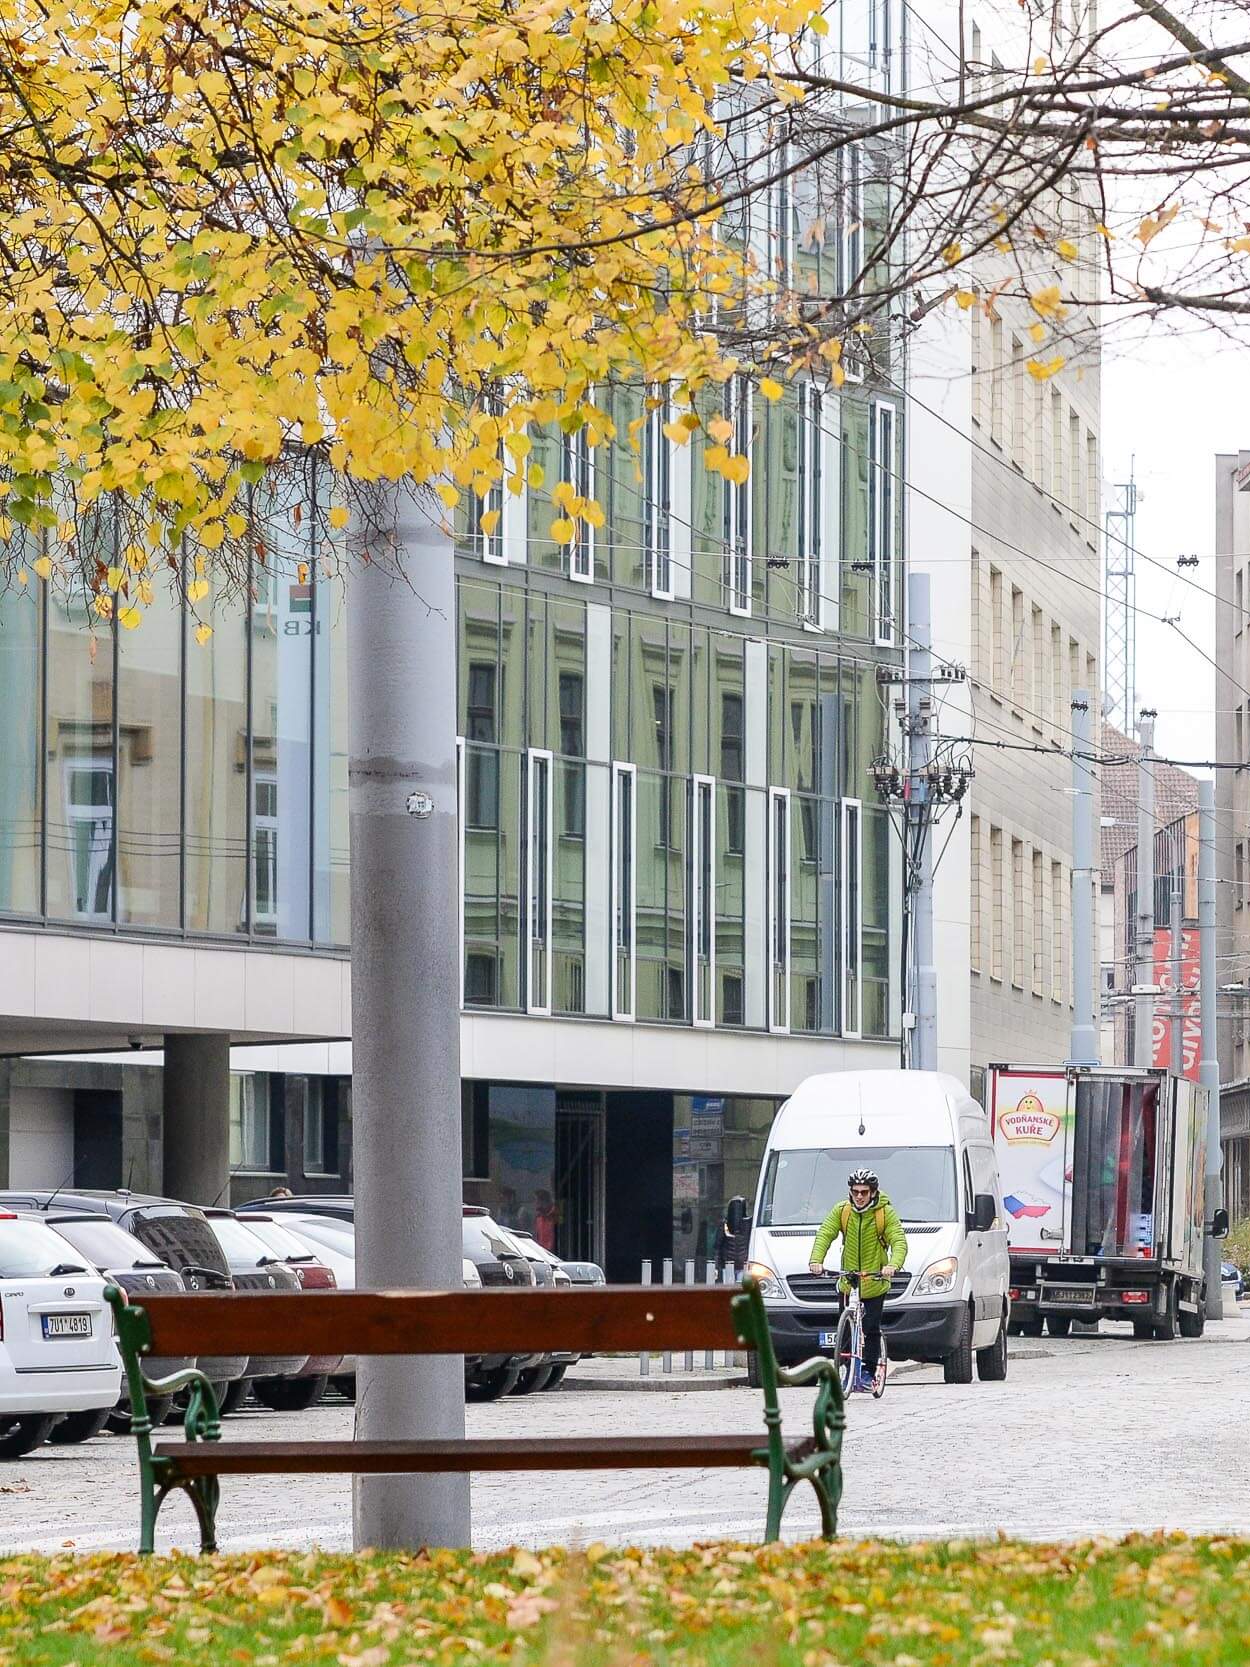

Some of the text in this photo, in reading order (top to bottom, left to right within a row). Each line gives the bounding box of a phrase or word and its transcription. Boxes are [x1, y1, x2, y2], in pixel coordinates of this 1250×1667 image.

[1015, 1124, 1043, 1135] KUŘE
[49, 1318, 88, 1333] 7U1 4819
